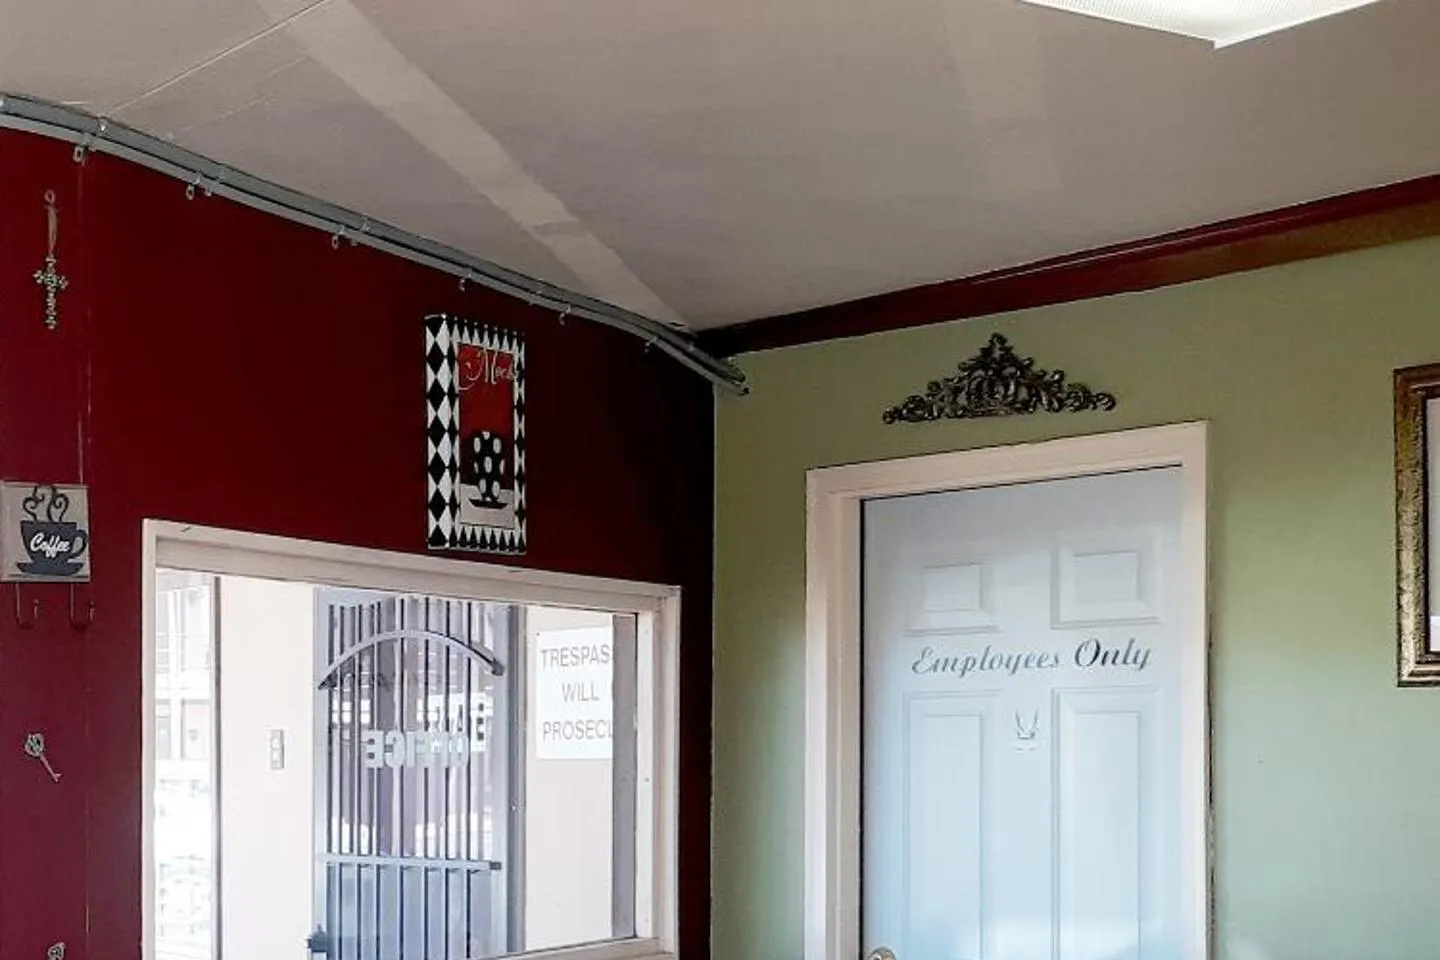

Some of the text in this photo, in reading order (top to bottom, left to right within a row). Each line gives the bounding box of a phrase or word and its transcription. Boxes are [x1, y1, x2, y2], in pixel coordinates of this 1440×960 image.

[30, 532, 70, 558] Coffee
[911, 637, 1152, 678] Employees Only
[561, 682, 600, 703] WILL
